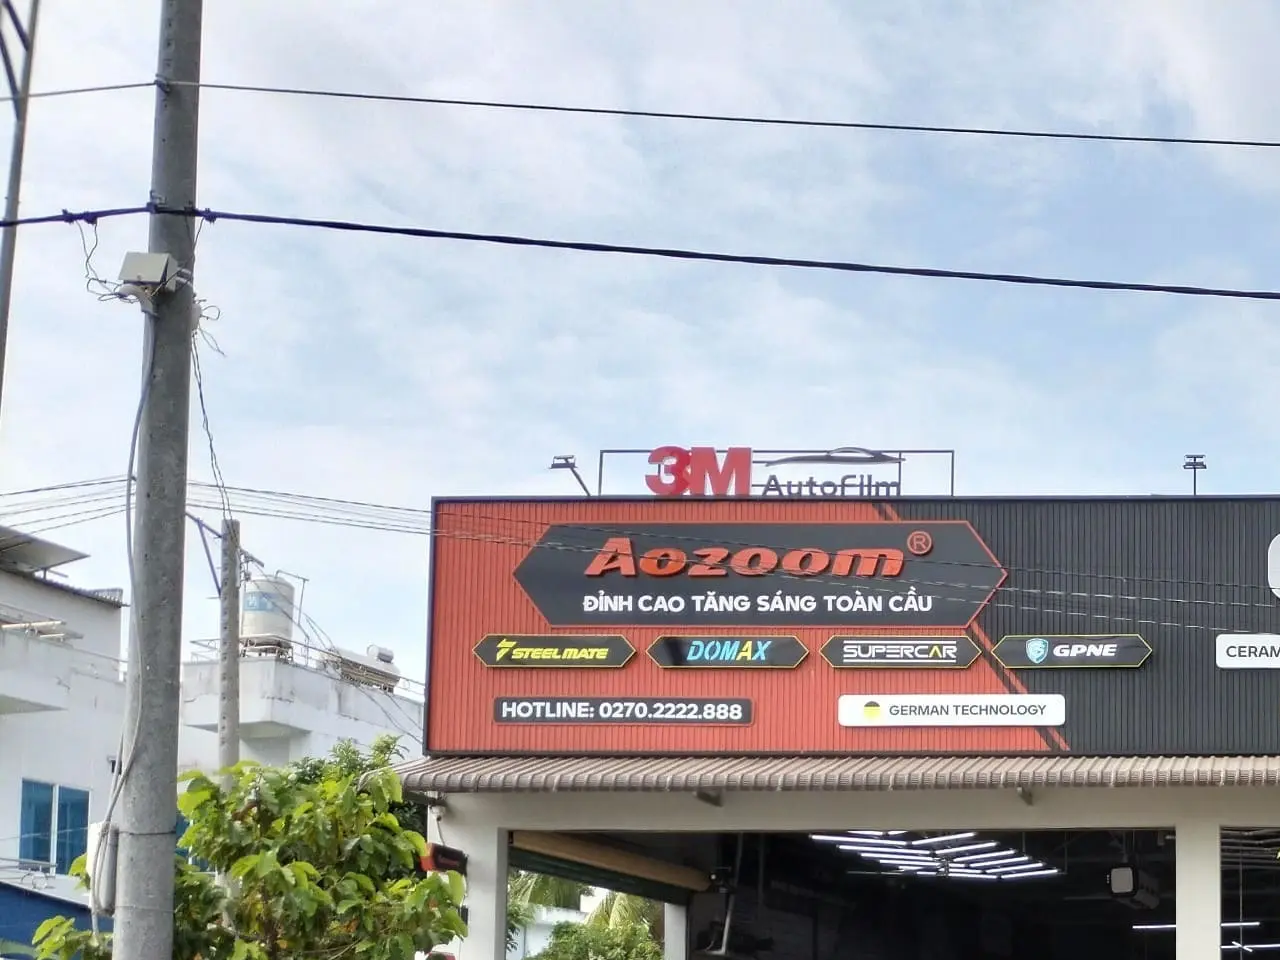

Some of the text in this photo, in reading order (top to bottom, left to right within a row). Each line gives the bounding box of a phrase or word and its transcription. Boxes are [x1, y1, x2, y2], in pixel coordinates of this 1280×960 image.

[646, 446, 752, 496] 3M
[763, 473, 902, 497] AutoFilm
[583, 537, 904, 578] Aozoom
[583, 585, 933, 613] ĐỈNH CAO TĂNG SÁNG TOÀN CẦU
[512, 646, 609, 660] STEELMATE
[685, 639, 772, 662] DOMAX
[843, 644, 957, 659] SUPERCAR
[1052, 643, 1118, 657] GPNE
[502, 701, 743, 720] HOTLINE: 0270.2222.888
[889, 703, 1047, 717] GERMAN TECHNOLOGY
